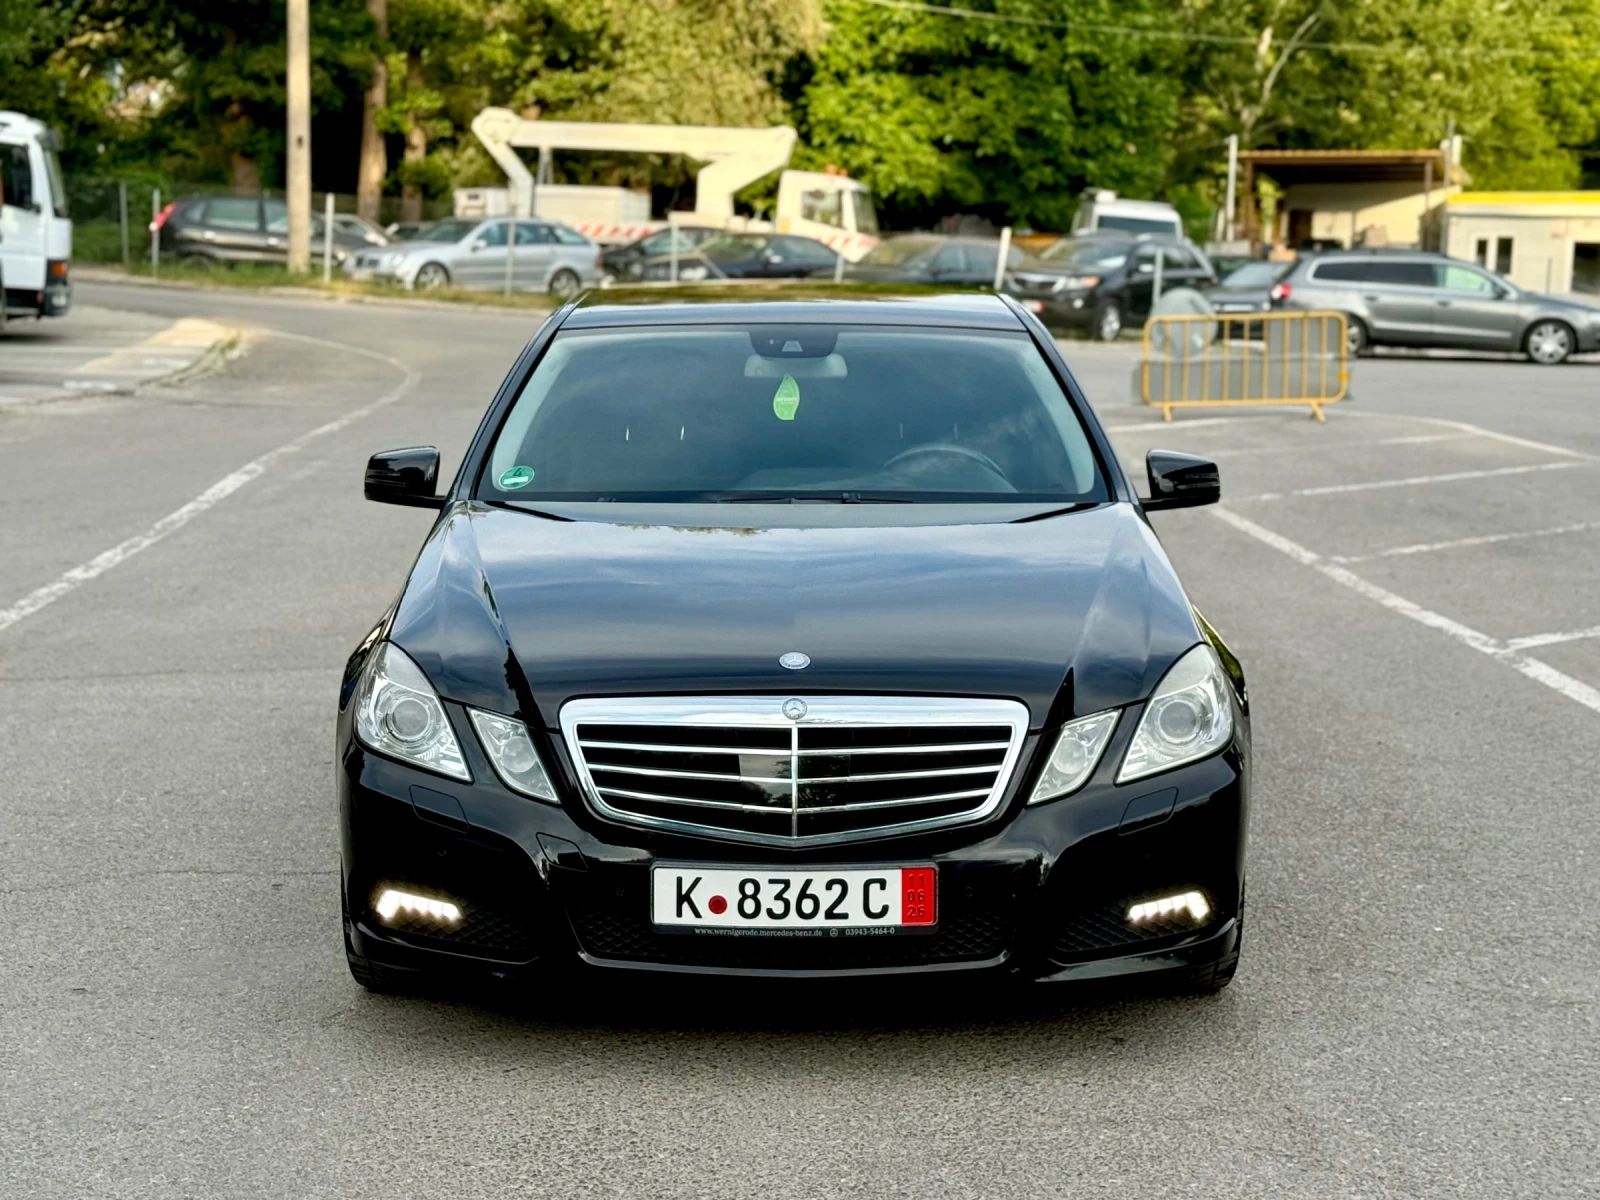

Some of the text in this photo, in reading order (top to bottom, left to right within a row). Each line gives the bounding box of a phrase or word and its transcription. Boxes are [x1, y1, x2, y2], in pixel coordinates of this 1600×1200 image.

[512, 467, 523, 477] 4
[908, 873, 925, 888] 11
[675, 876, 890, 920] K 8362 C
[907, 889, 926, 903] 06
[907, 904, 926, 919] 26
[694, 927, 896, 937] www.wernigerode.mercedes-benz.de 03943-5464-0
